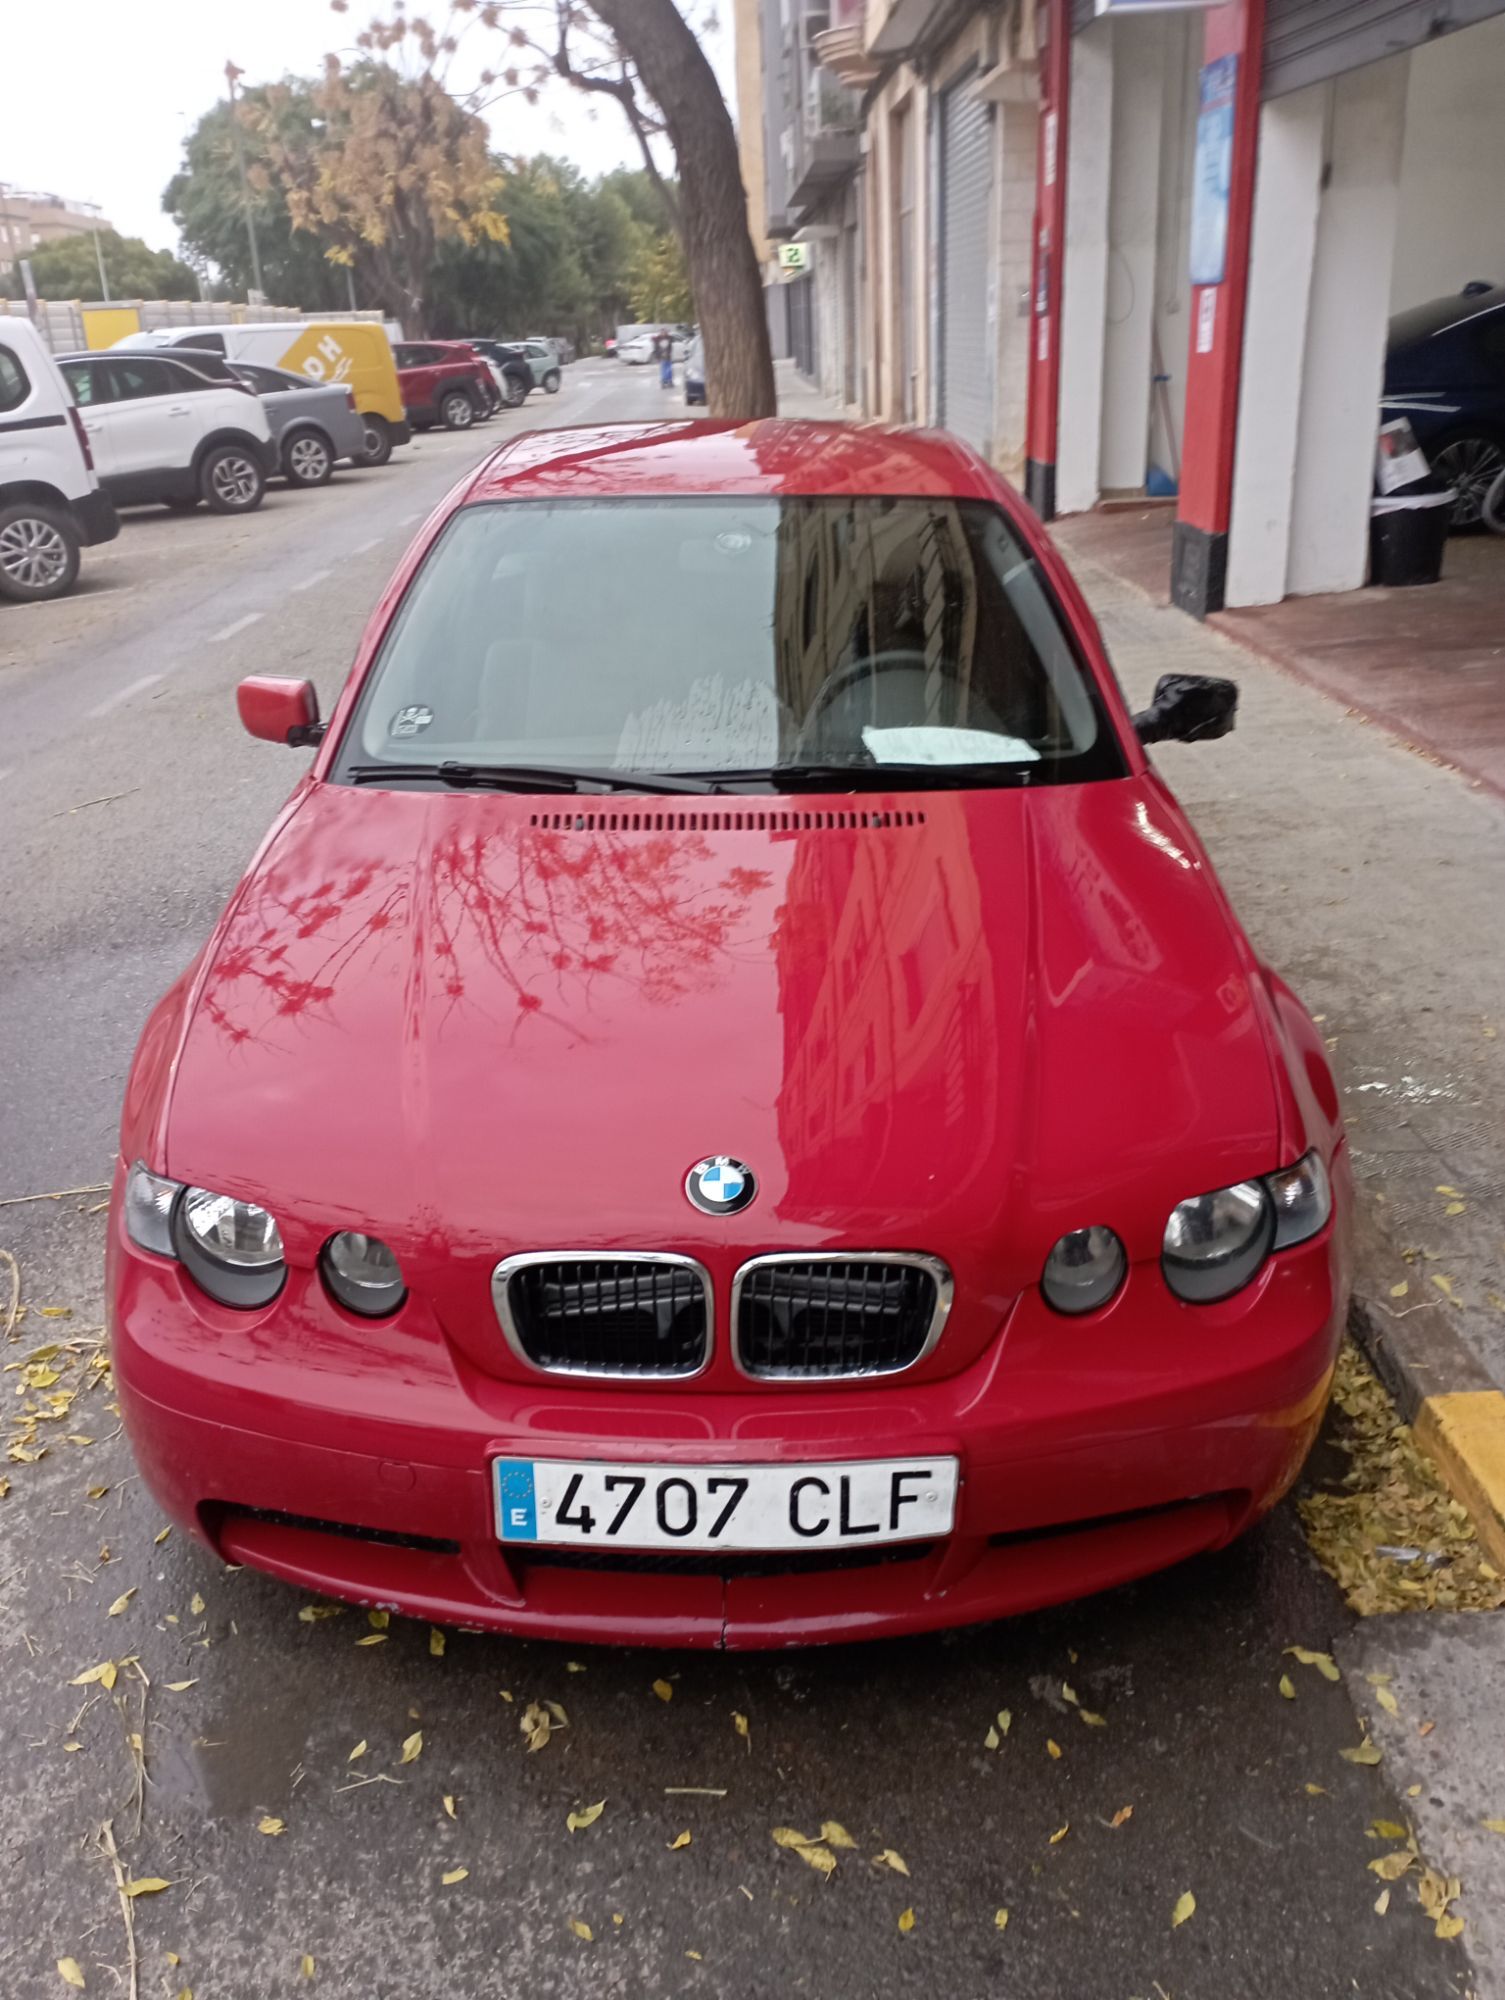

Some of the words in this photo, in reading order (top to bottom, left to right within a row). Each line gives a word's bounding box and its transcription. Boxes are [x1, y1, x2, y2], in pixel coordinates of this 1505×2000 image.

[694, 1155, 752, 1175] BMW
[555, 1473, 749, 1538] 4707
[789, 1470, 932, 1538] CLF
[510, 1508, 528, 1526] E
